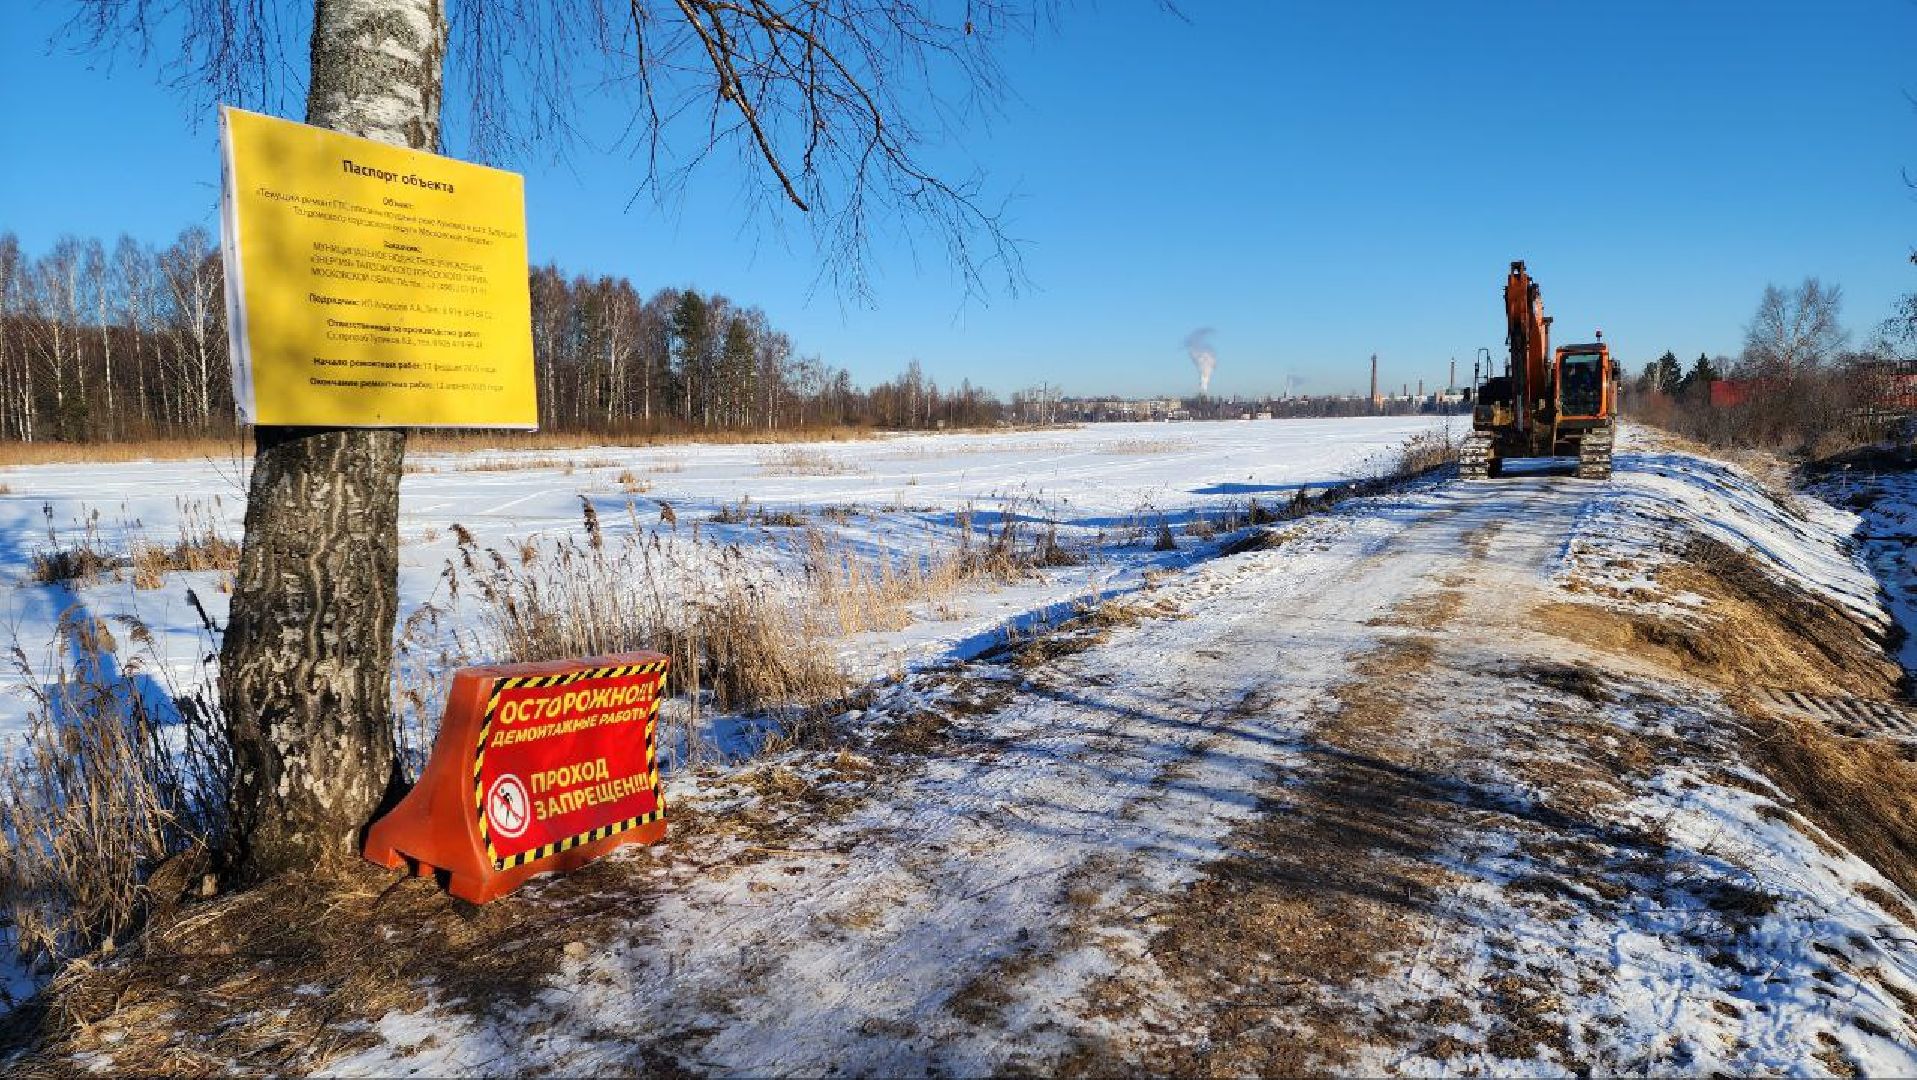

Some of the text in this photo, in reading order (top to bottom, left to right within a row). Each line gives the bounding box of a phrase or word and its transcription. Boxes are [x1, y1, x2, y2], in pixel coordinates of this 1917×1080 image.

[343, 159, 455, 194] Паспорт объекта
[491, 707, 649, 748] ДЕМОНТАЖНЫЕ РАБОТЫ
[530, 758, 609, 794] ПРОХОД
[534, 771, 650, 820] ЗАПРЕЩЕН!!!
